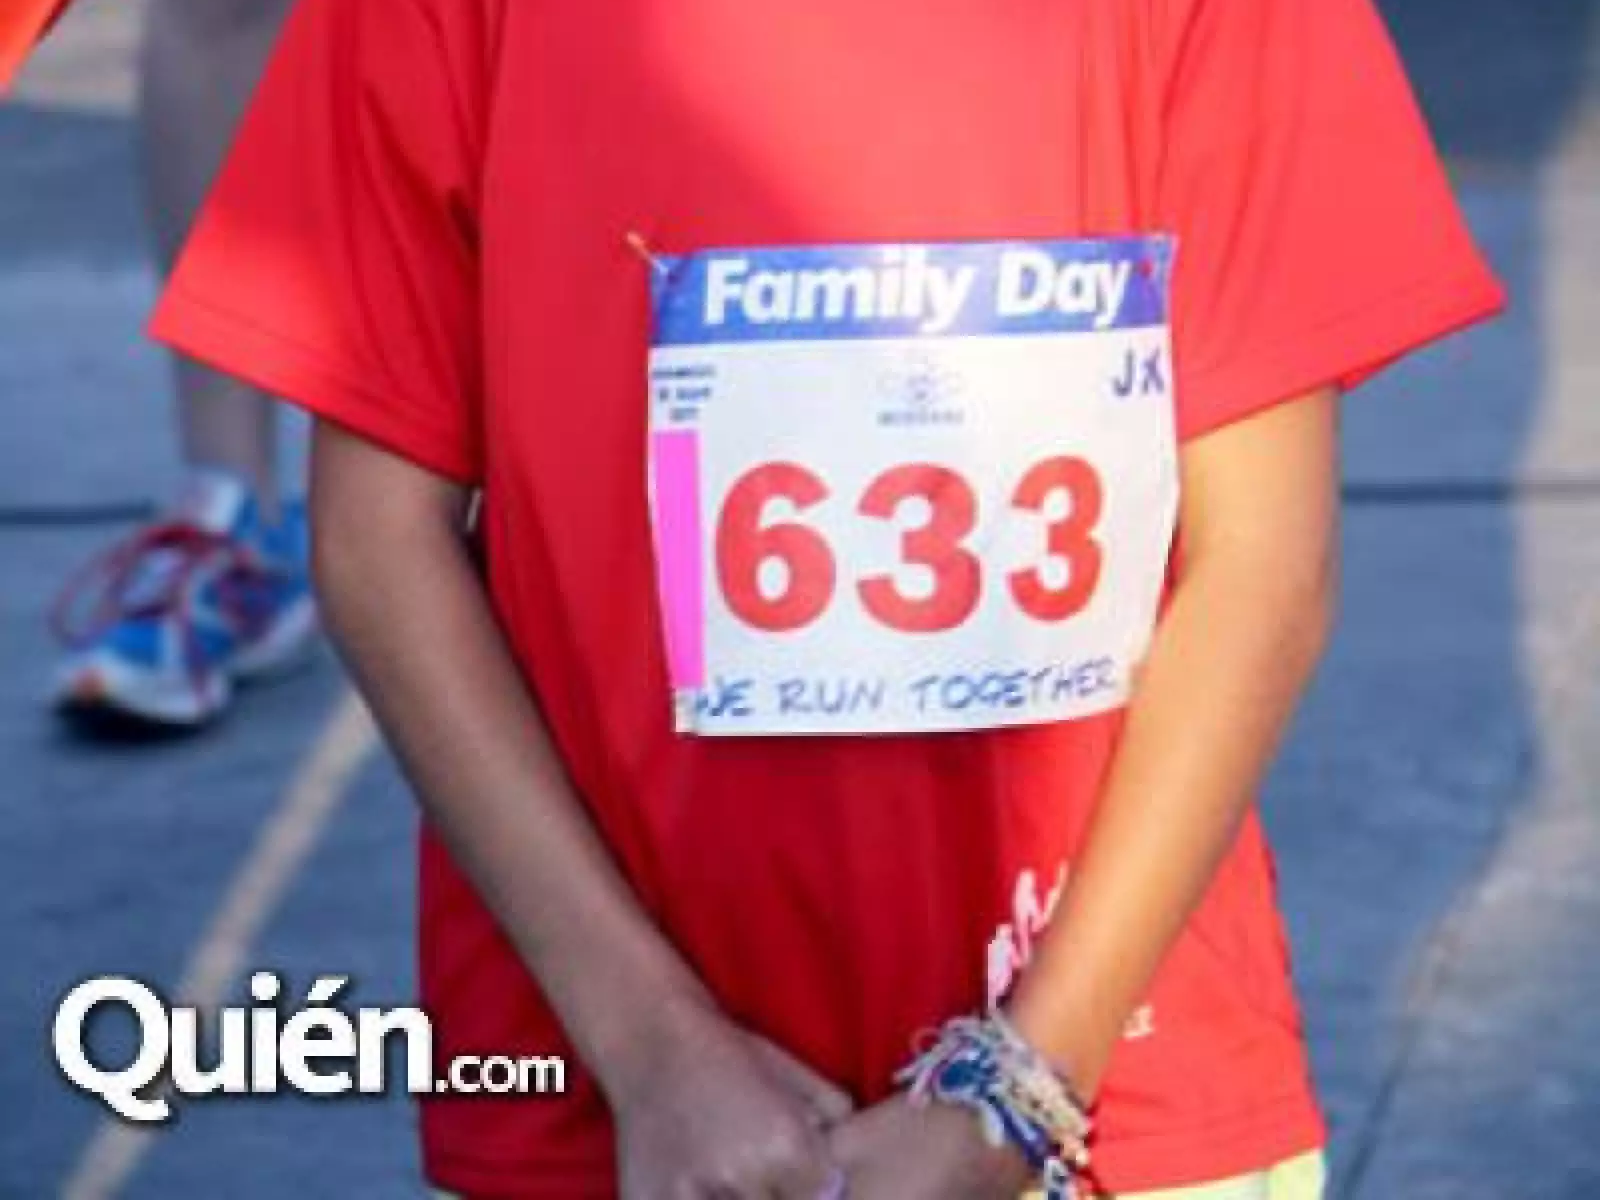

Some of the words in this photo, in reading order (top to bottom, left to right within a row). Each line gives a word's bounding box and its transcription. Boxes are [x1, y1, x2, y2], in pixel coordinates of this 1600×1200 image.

[702, 246, 975, 334] Family
[996, 251, 1130, 325] Day
[714, 455, 1105, 634] 633
[693, 672, 756, 717] WE
[778, 673, 888, 716] RUN
[908, 655, 1118, 714] TOGETHER
